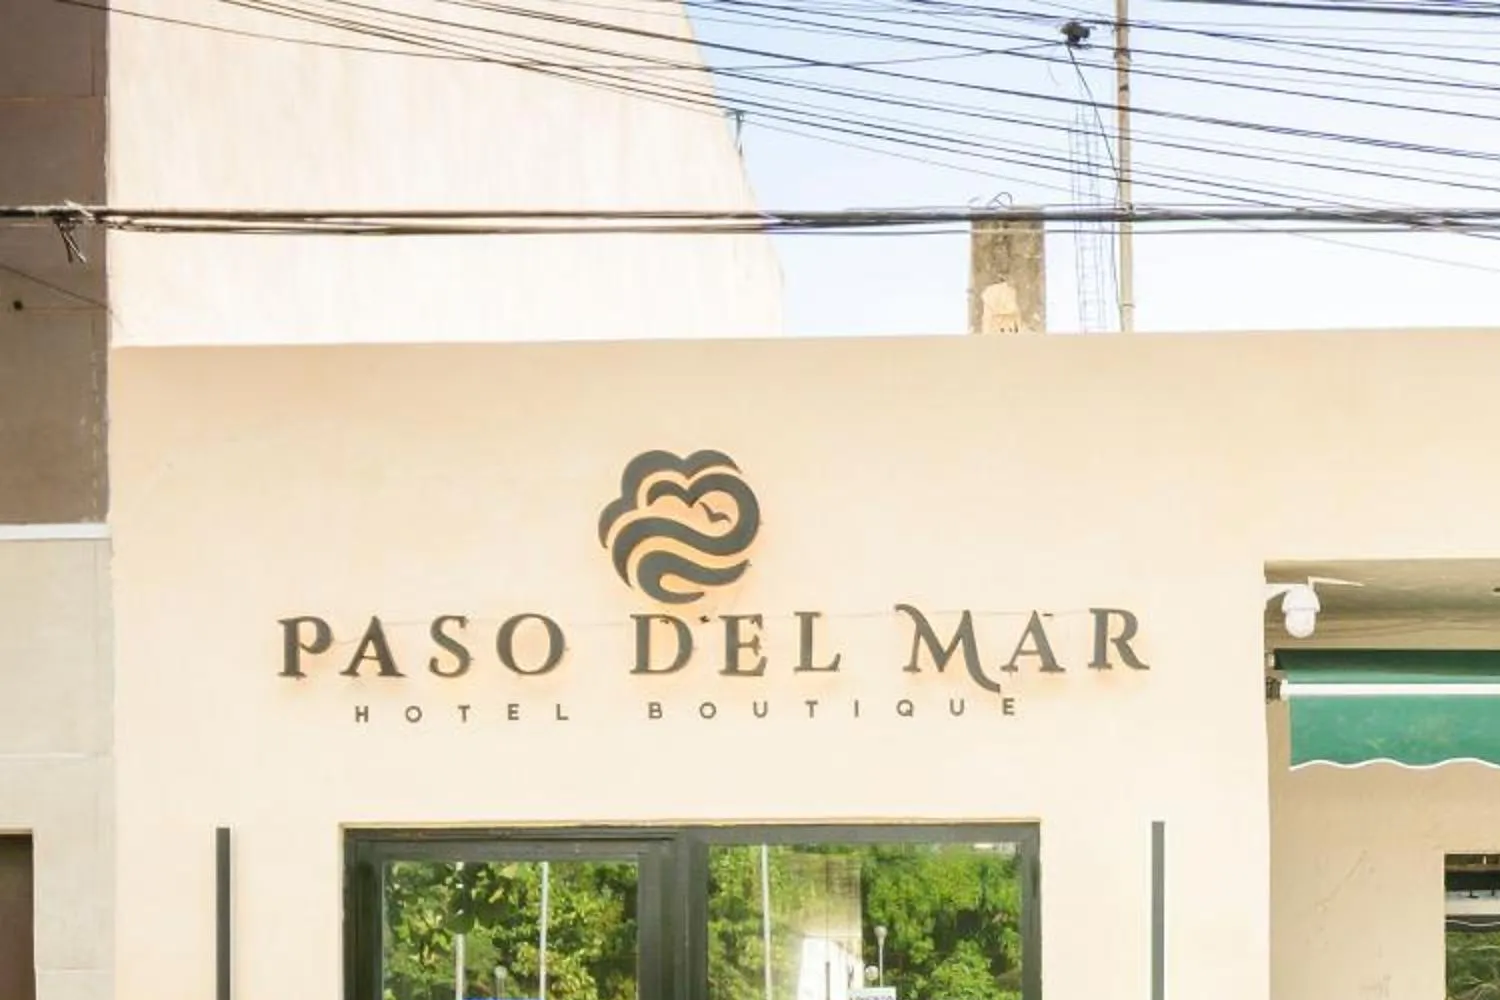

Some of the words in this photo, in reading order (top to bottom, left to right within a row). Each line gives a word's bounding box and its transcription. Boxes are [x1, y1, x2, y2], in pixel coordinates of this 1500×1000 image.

[279, 613, 565, 679] PASO
[895, 604, 1150, 693] MAR
[355, 703, 569, 723] HOTEL
[648, 697, 1015, 720] BOUTIQUE
